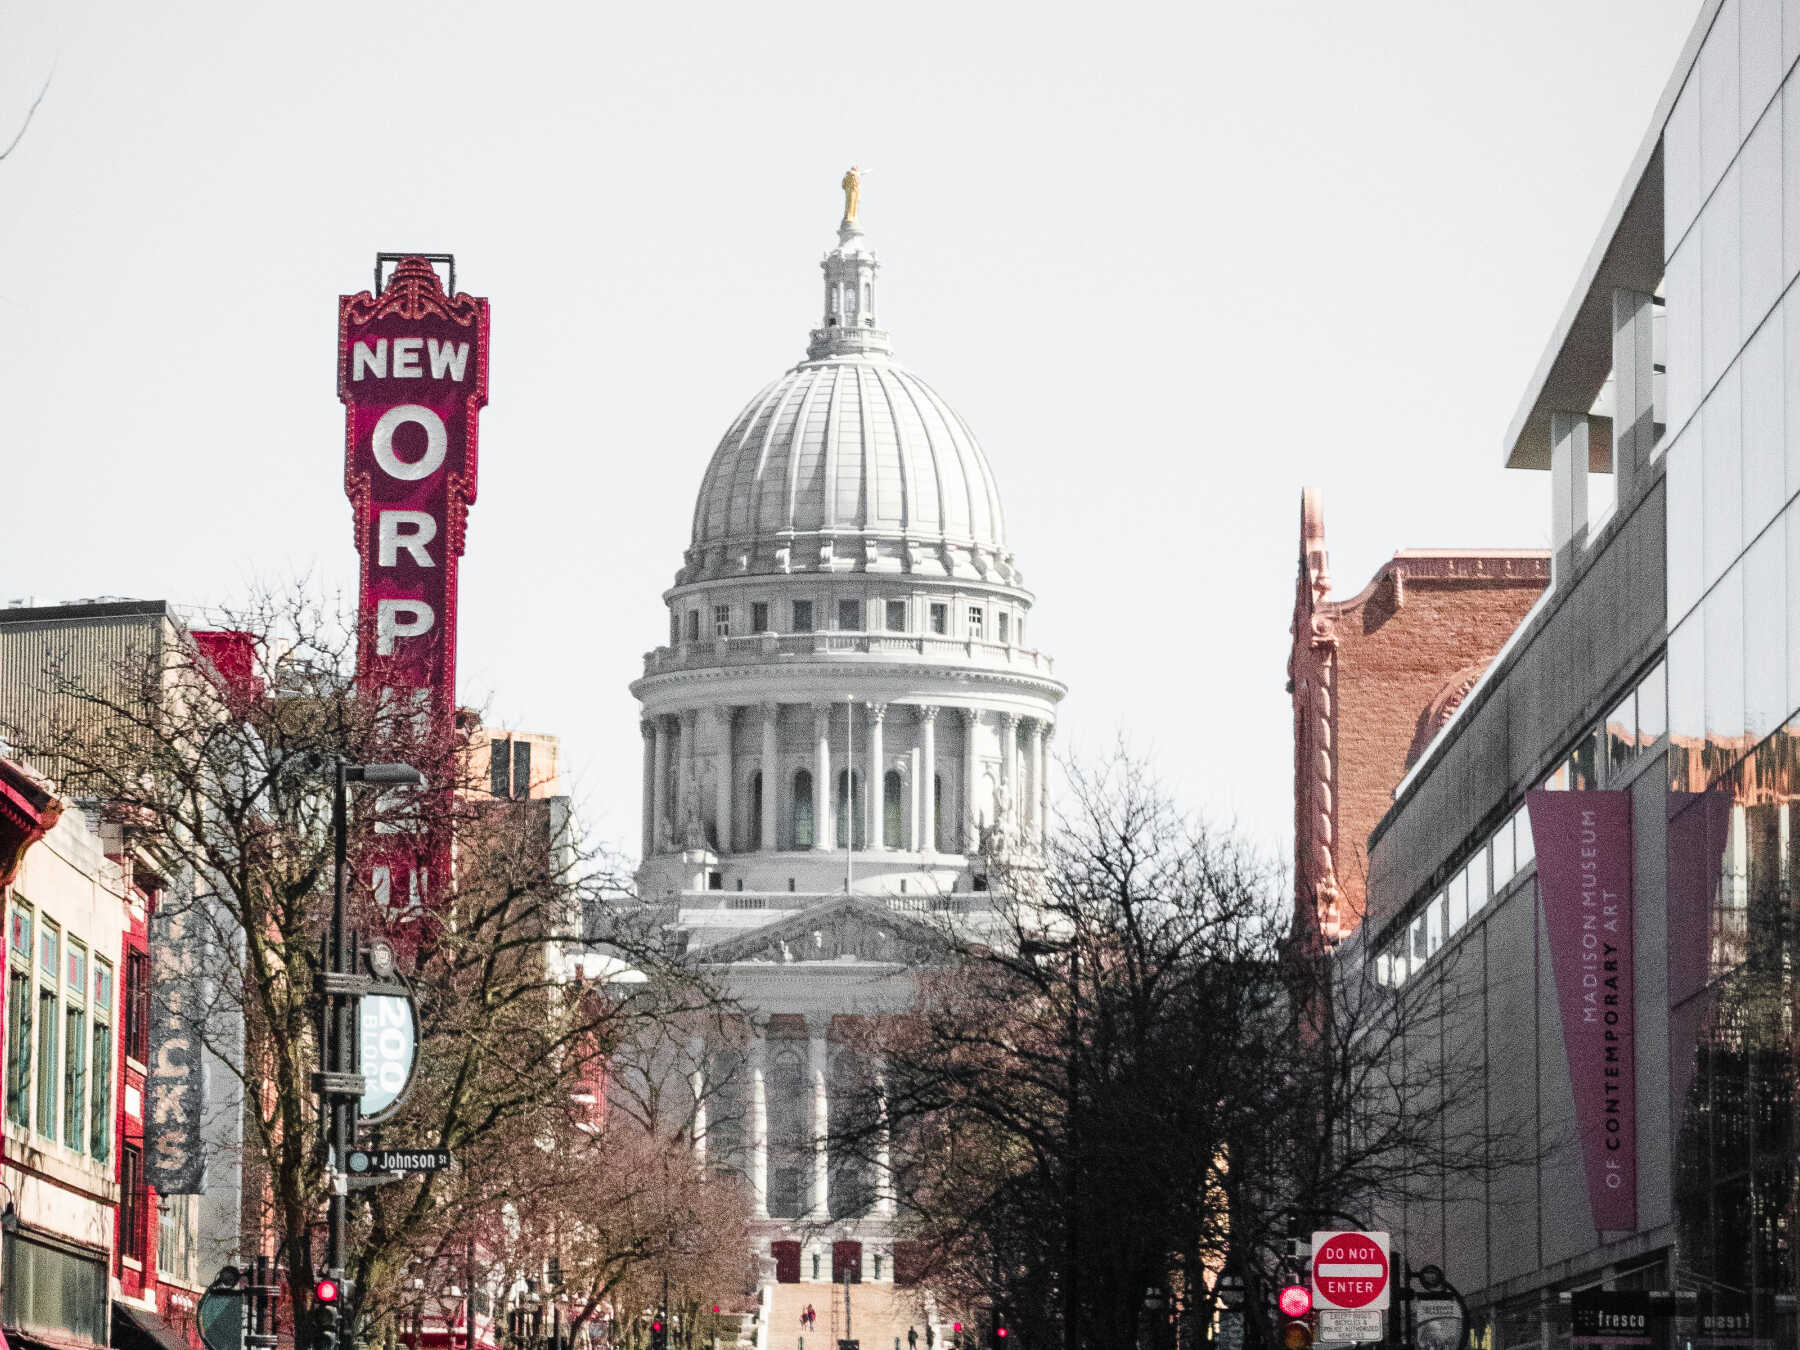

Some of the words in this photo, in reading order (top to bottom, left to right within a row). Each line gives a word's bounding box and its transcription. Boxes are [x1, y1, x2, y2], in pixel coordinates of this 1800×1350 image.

[353, 337, 469, 382] NEW
[1582, 811, 1597, 907] MUSEUM
[1603, 890, 1618, 932] ART
[1583, 915, 1598, 1023] MADISON
[364, 1015, 378, 1091] BLOCK
[379, 996, 407, 1094] 200
[1604, 943, 1621, 1151] CONTEMPORARY
[371, 1156, 378, 1165] W
[380, 1151, 435, 1169] Johnson
[438, 1154, 447, 1164] St
[1606, 1160, 1621, 1189] OF
[1326, 1247, 1344, 1260] DO
[1349, 1247, 1376, 1260] NOT
[1328, 1281, 1374, 1293] ENTER
[1599, 1310, 1645, 1327] fresco
